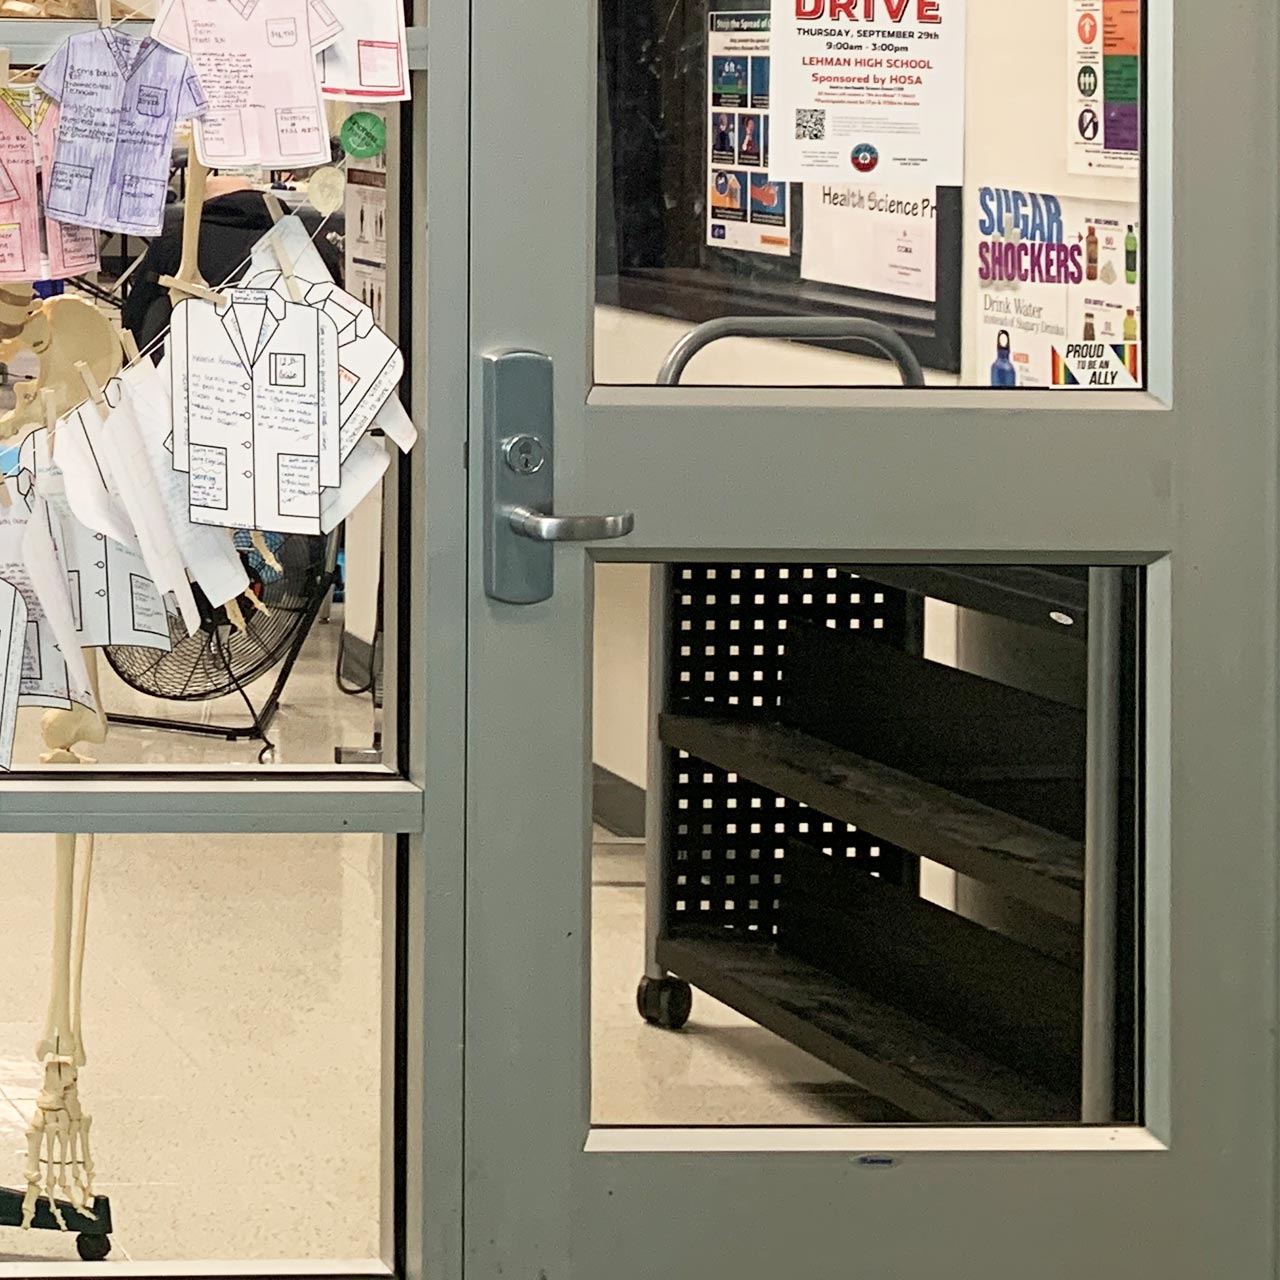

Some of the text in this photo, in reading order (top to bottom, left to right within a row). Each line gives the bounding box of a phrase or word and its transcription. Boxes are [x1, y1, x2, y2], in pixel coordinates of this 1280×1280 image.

[797, 28, 854, 38] THURSDAY,
[857, 30, 914, 39] SEPTEMBER
[826, 42, 863, 50] 9:00am
[871, 43, 908, 53] 3:00pm
[802, 57, 933, 69] LEHMAN HIGH SCHOOL
[812, 73, 923, 85] Sponsored by HOSA
[822, 185, 864, 209] Health
[868, 191, 919, 216] Science
[979, 187, 1063, 244] SUGAR
[979, 242, 1083, 284] SHOCKERS
[984, 294, 1043, 318] Drink Water
[1066, 344, 1105, 358] PROUD
[1077, 360, 1110, 369] TO BE AN
[1089, 371, 1118, 385] ALLY
